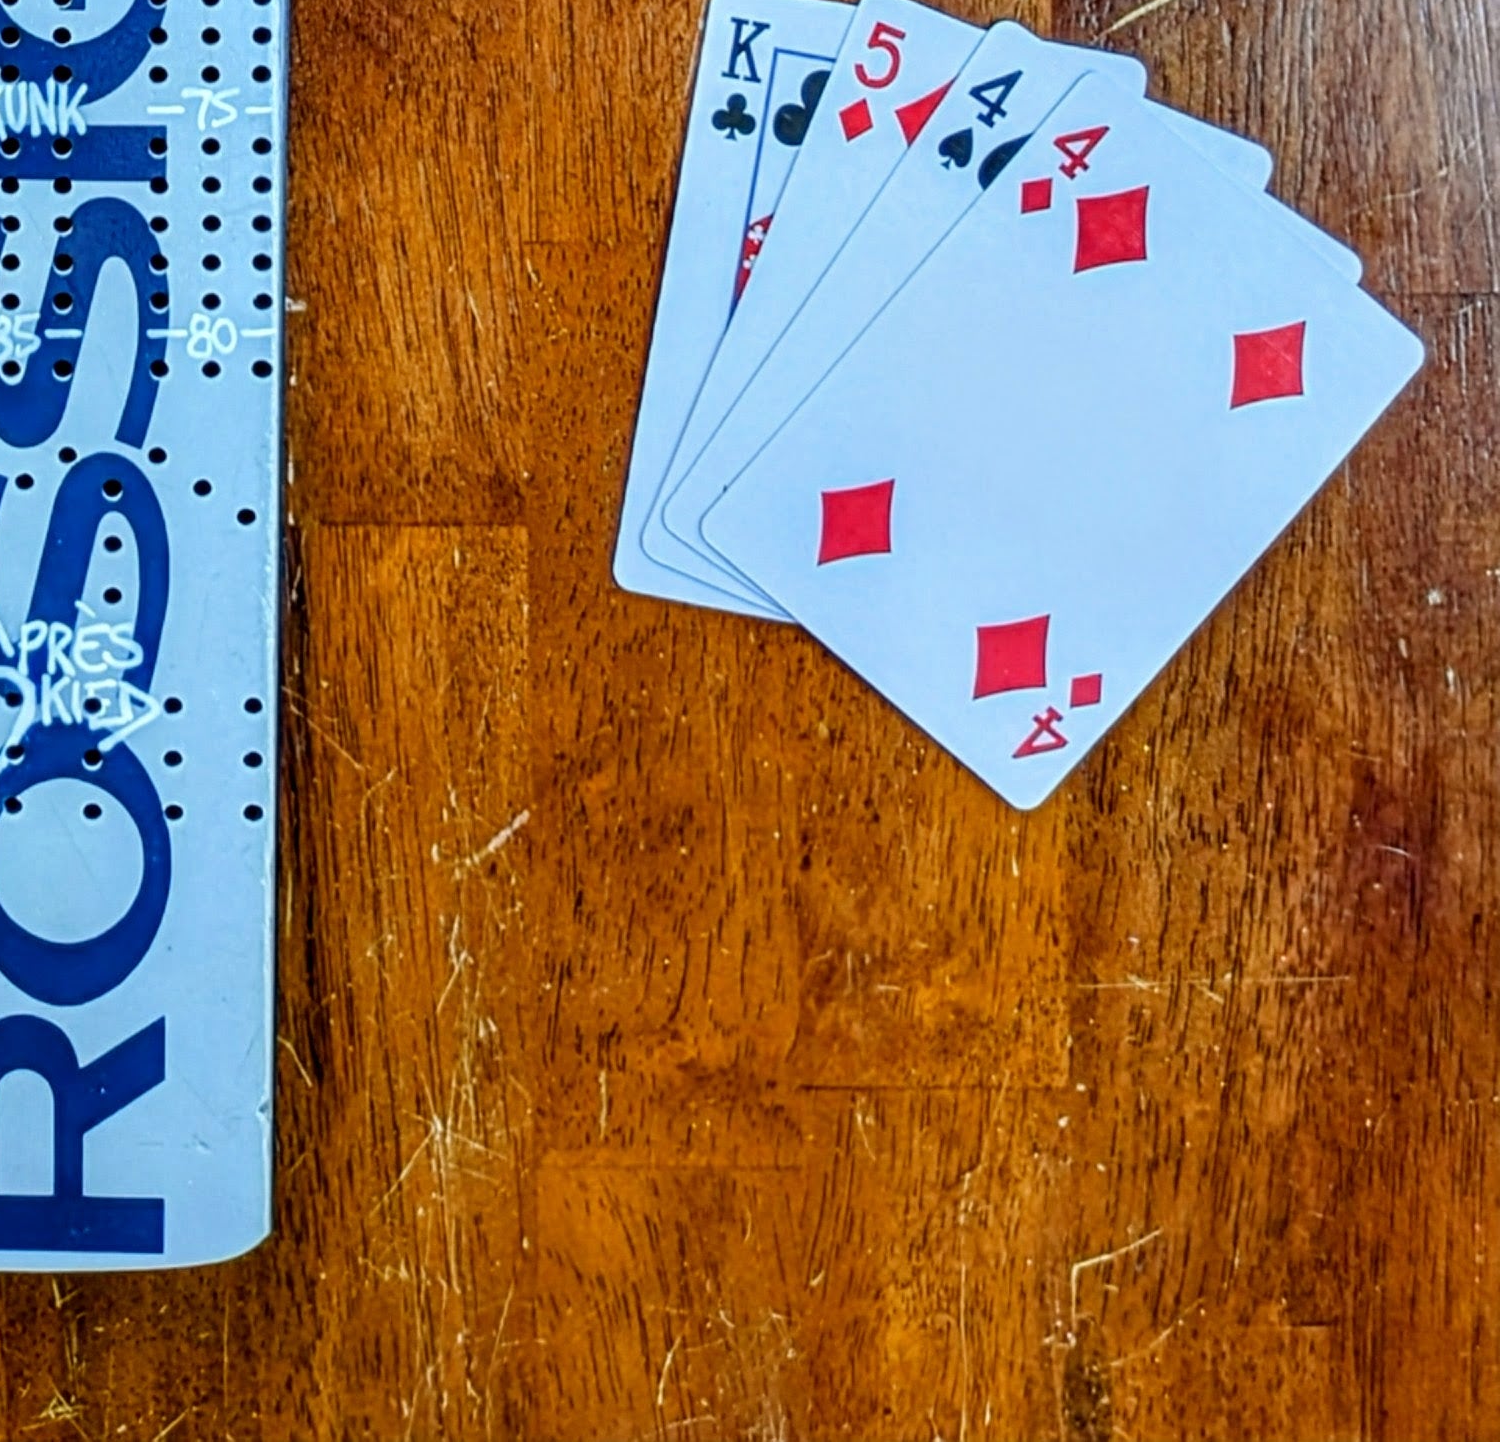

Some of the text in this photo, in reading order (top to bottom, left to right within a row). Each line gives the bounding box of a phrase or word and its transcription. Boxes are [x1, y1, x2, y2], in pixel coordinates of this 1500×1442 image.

[721, 18, 773, 82] K
[854, 21, 908, 88] 5
[183, 90, 241, 129] 75
[968, 69, 1024, 129] 4
[1053, 125, 1110, 181] 4
[186, 314, 238, 358] 80
[1012, 707, 1068, 759] 4
